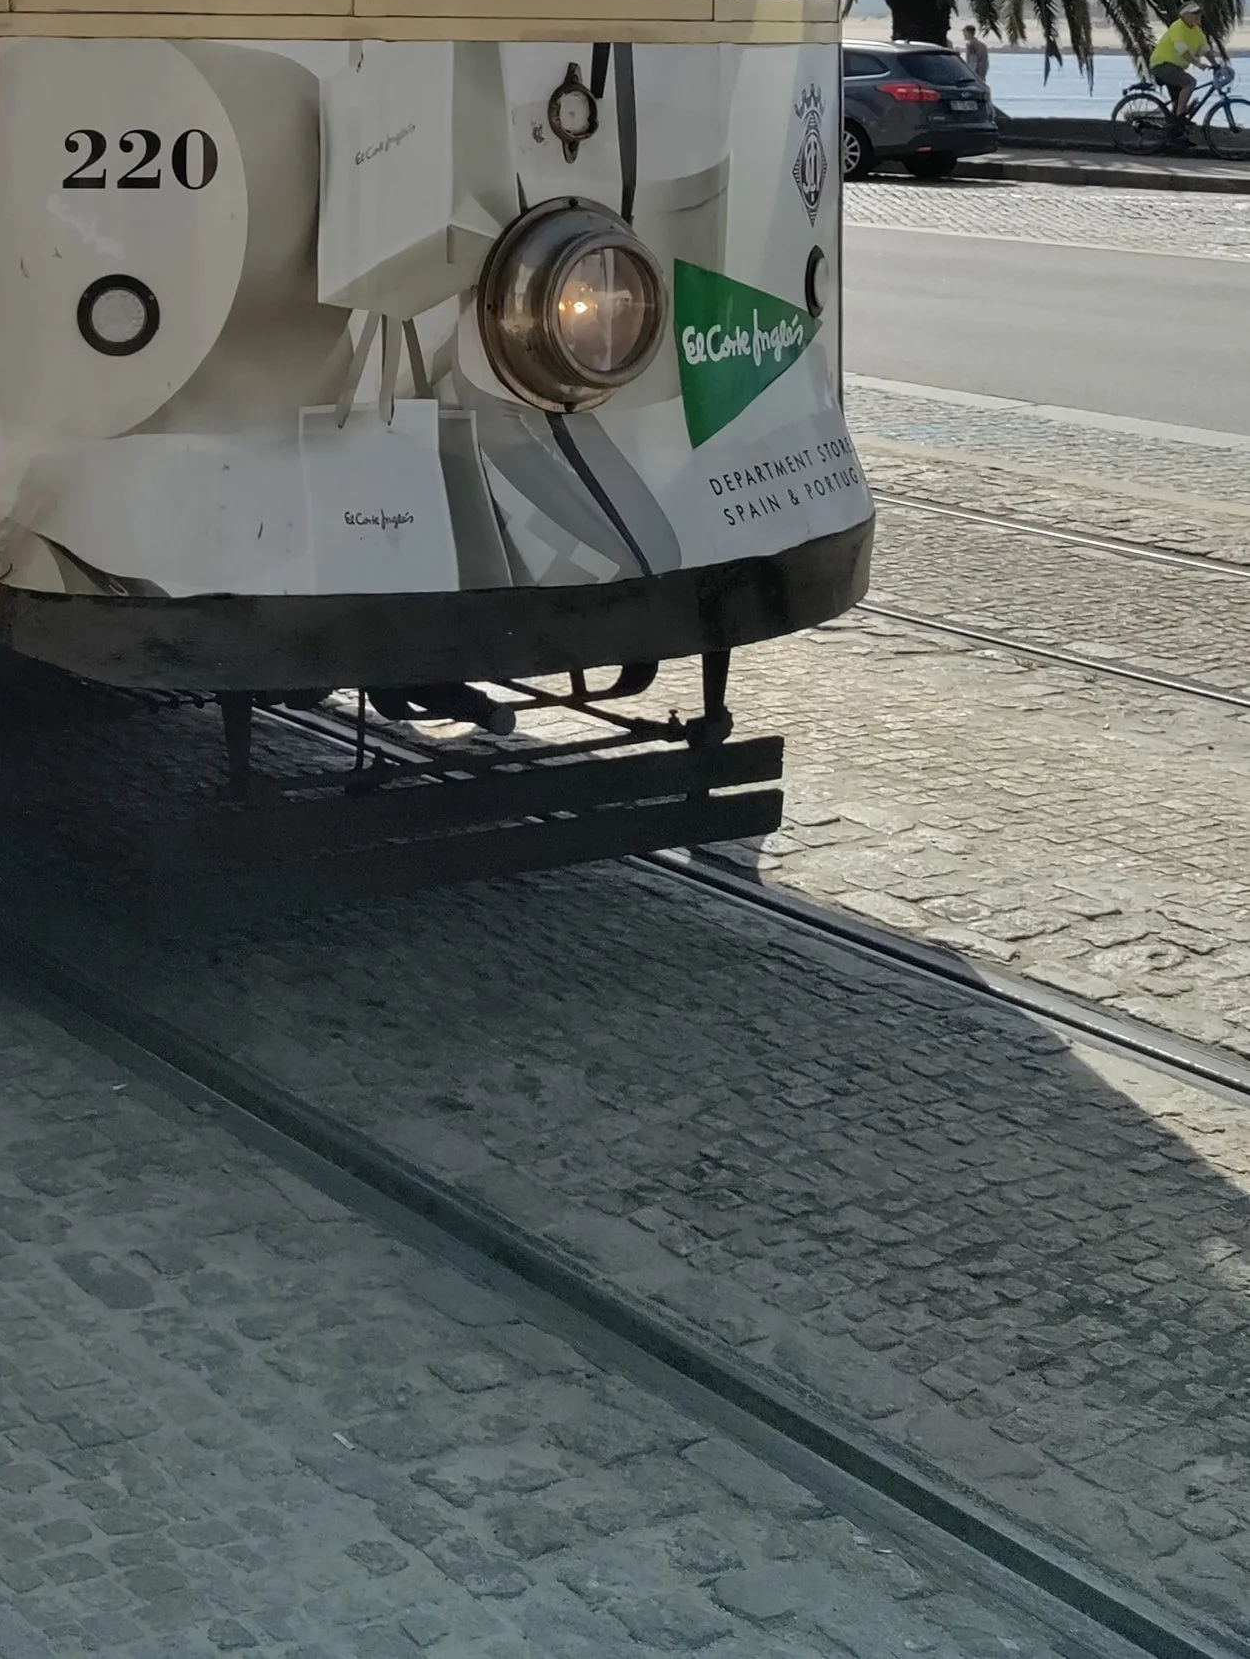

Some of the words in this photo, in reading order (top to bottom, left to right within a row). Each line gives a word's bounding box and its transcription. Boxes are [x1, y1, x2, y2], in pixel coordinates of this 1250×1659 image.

[62, 128, 219, 191] 220
[682, 325, 707, 365] El
[707, 324, 751, 362] Corte
[752, 308, 804, 367] Inglés
[708, 449, 814, 496] DEPARTMENT
[816, 435, 856, 463] STORE
[723, 494, 782, 526] SPAIN
[787, 488, 800, 506] &
[804, 467, 861, 500] PORTUG
